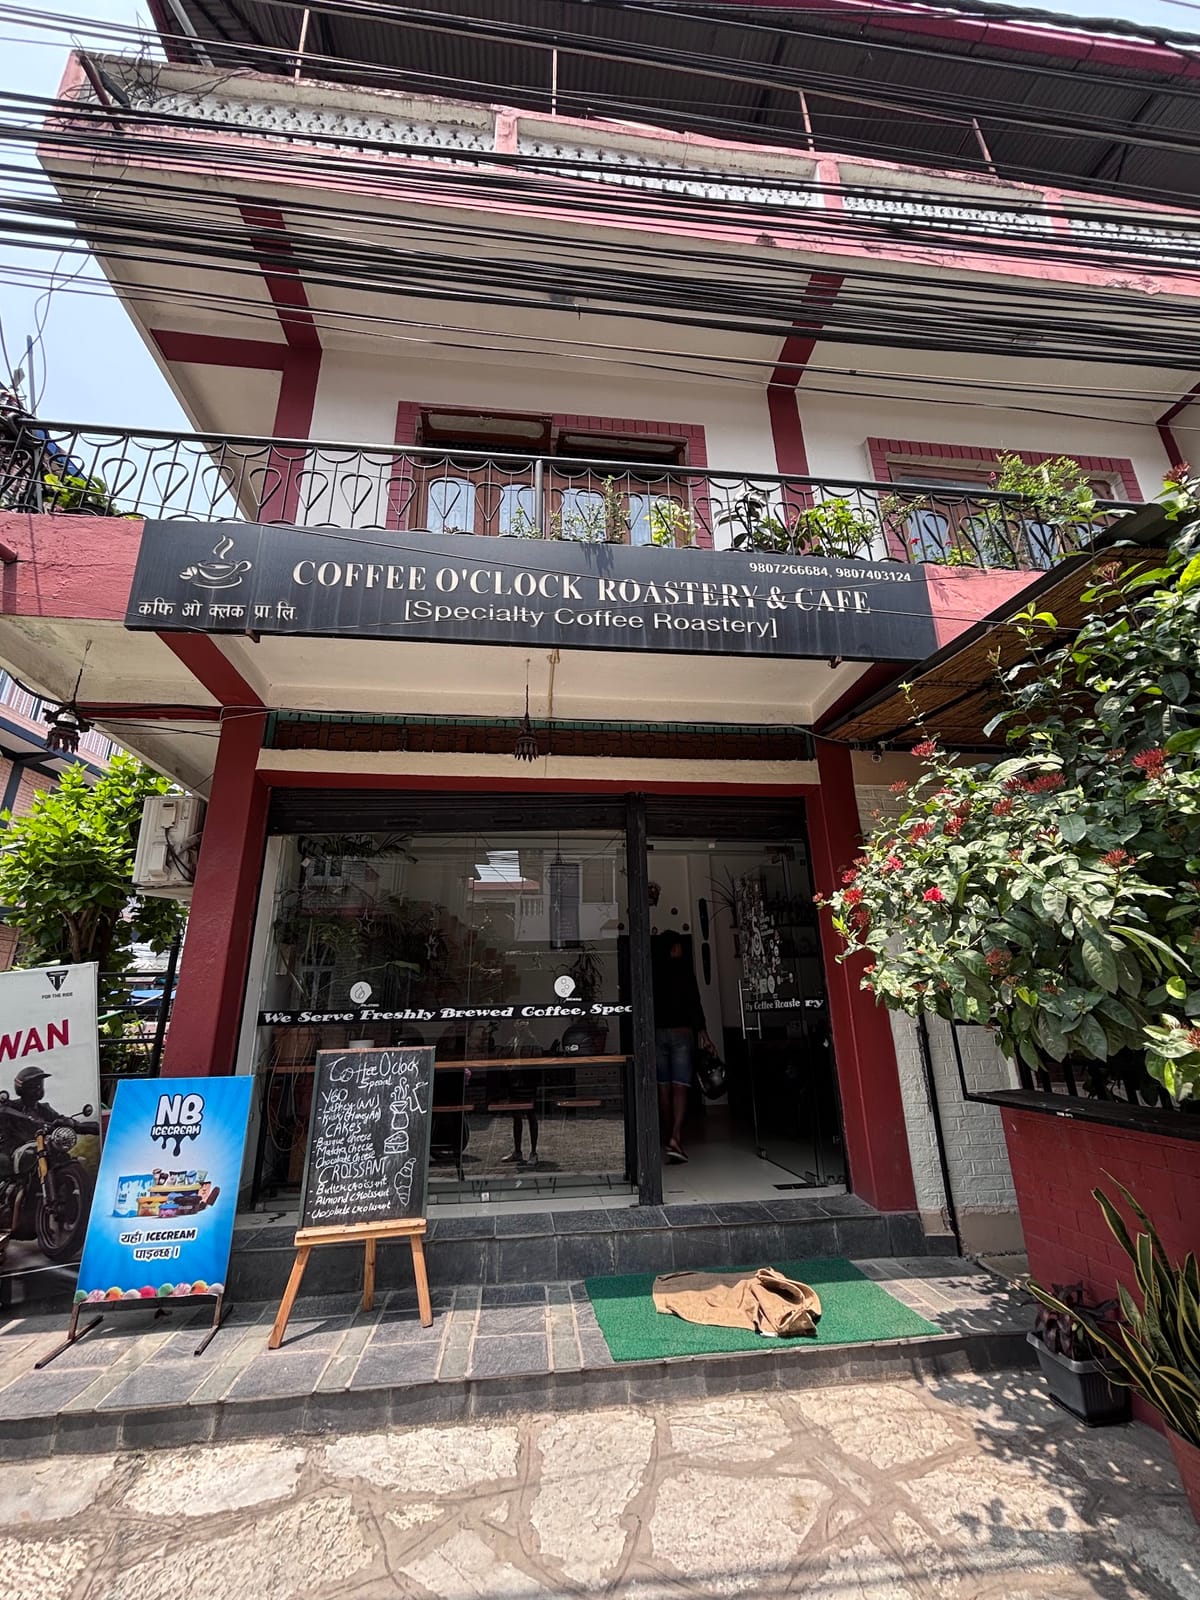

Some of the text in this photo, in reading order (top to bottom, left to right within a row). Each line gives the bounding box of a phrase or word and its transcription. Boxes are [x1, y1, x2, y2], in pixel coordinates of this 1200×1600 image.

[749, 562, 912, 582] 9807266684, 9807403124
[293, 560, 871, 615] COFFEE O'CLOCK ROASTERY & CAFE
[138, 597, 177, 616] कफि
[181, 600, 203, 617] ओ
[209, 603, 247, 619] क्लक
[404, 599, 778, 639] [Specialty Coffee Roastery]
[263, 1011, 292, 1024] We
[297, 1011, 354, 1023] Serve
[360, 1008, 436, 1022] Freshly
[440, 1006, 514, 1019] Brewed
[522, 1004, 586, 1017] Coffee,
[326, 1056, 379, 1083] Coffee
[155, 1092, 206, 1126] NB
[151, 1125, 202, 1137] ICECREAM
[319, 1156, 389, 1184] CROISSANT
[145, 1229, 196, 1242] ICECREAM
